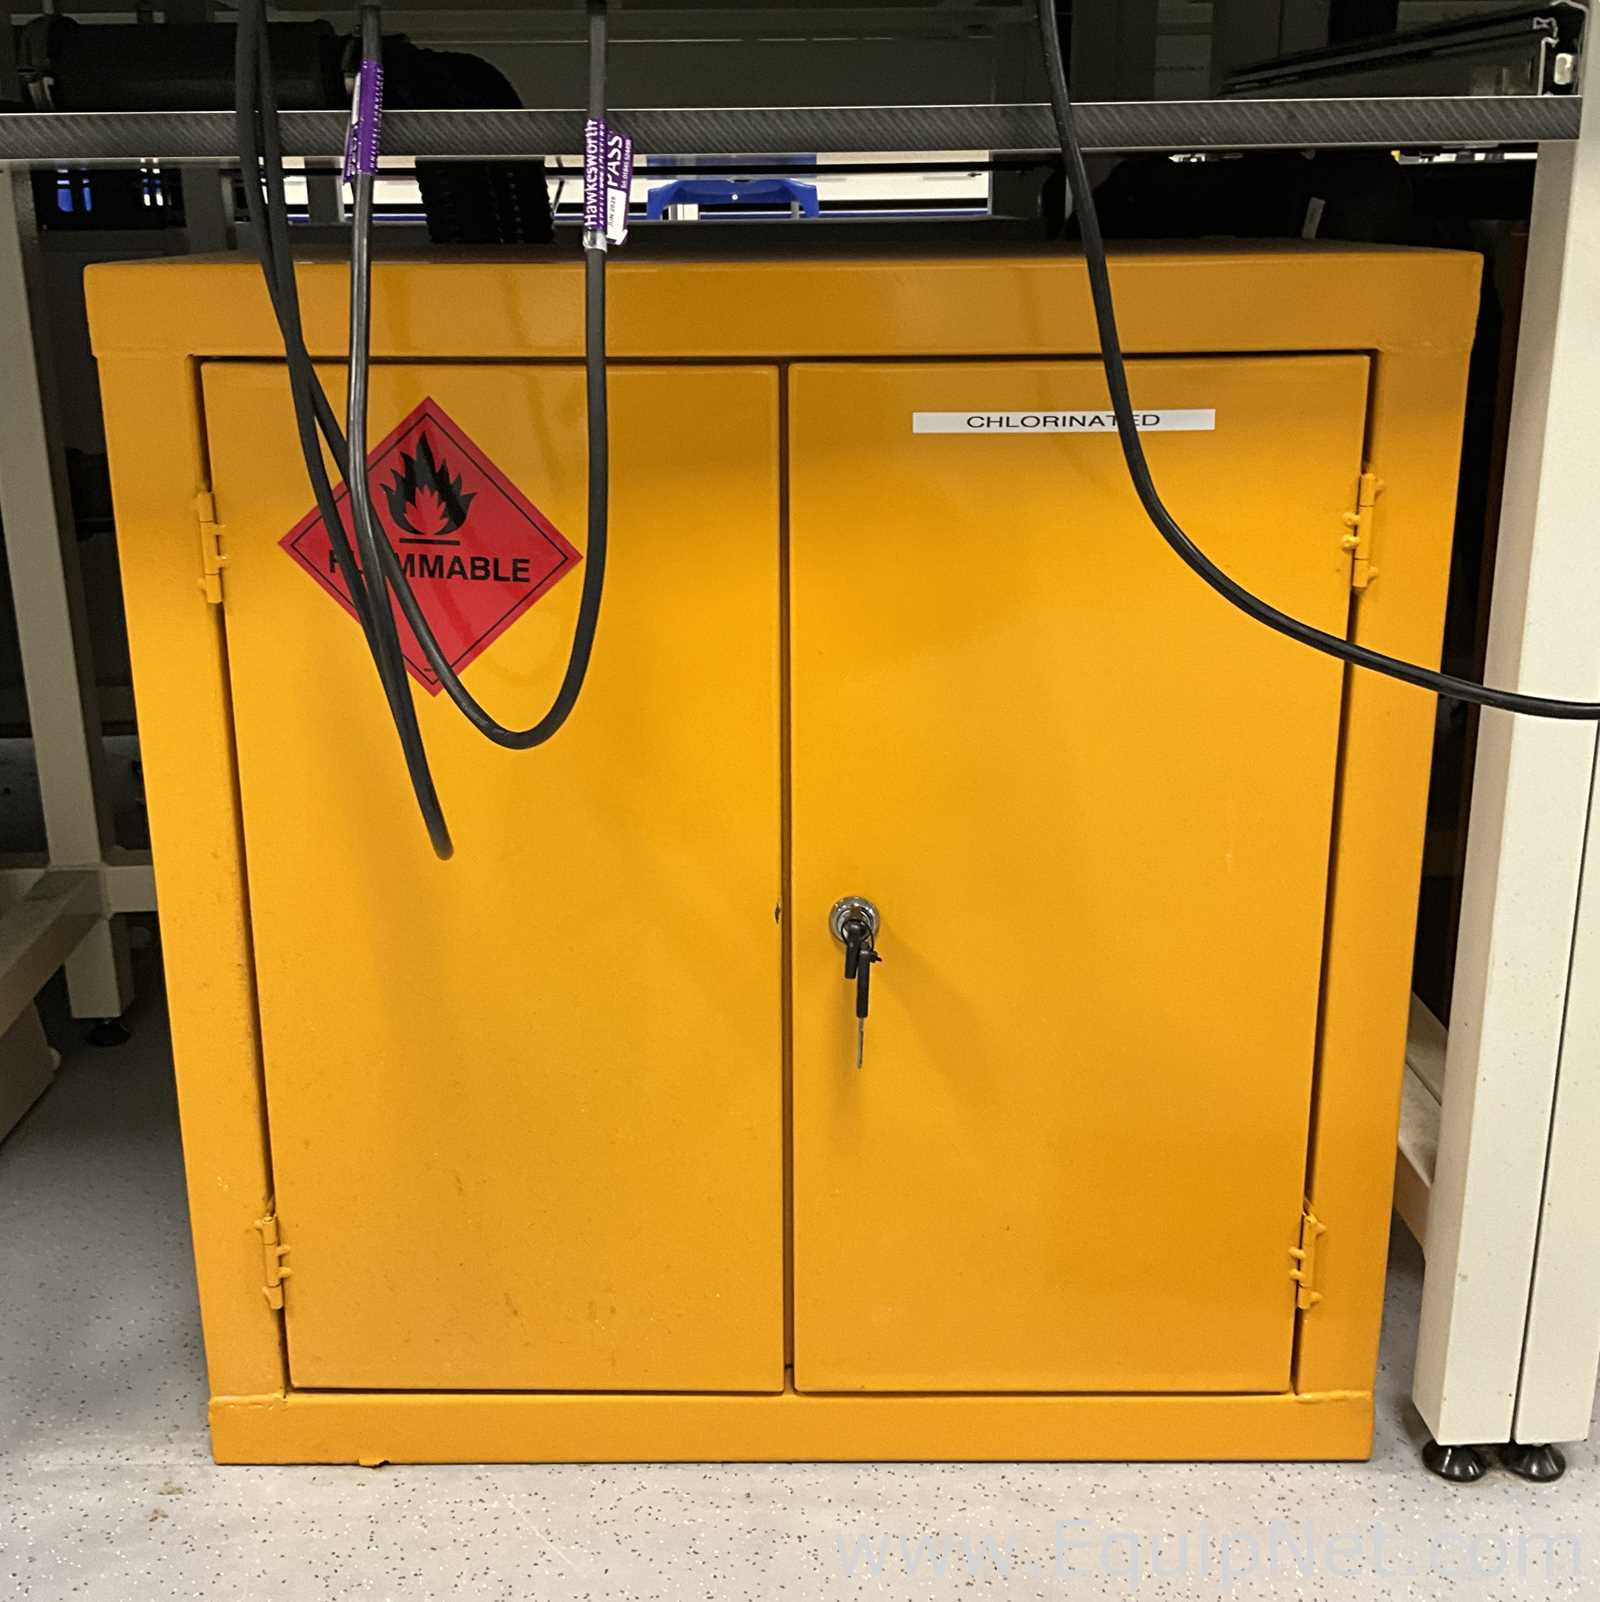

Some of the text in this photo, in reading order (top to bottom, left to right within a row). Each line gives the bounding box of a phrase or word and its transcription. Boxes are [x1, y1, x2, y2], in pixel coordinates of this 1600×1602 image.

[584, 118, 598, 227] Hawkesworth
[607, 135, 622, 187] PASS
[329, 549, 531, 583] FMMABLE
